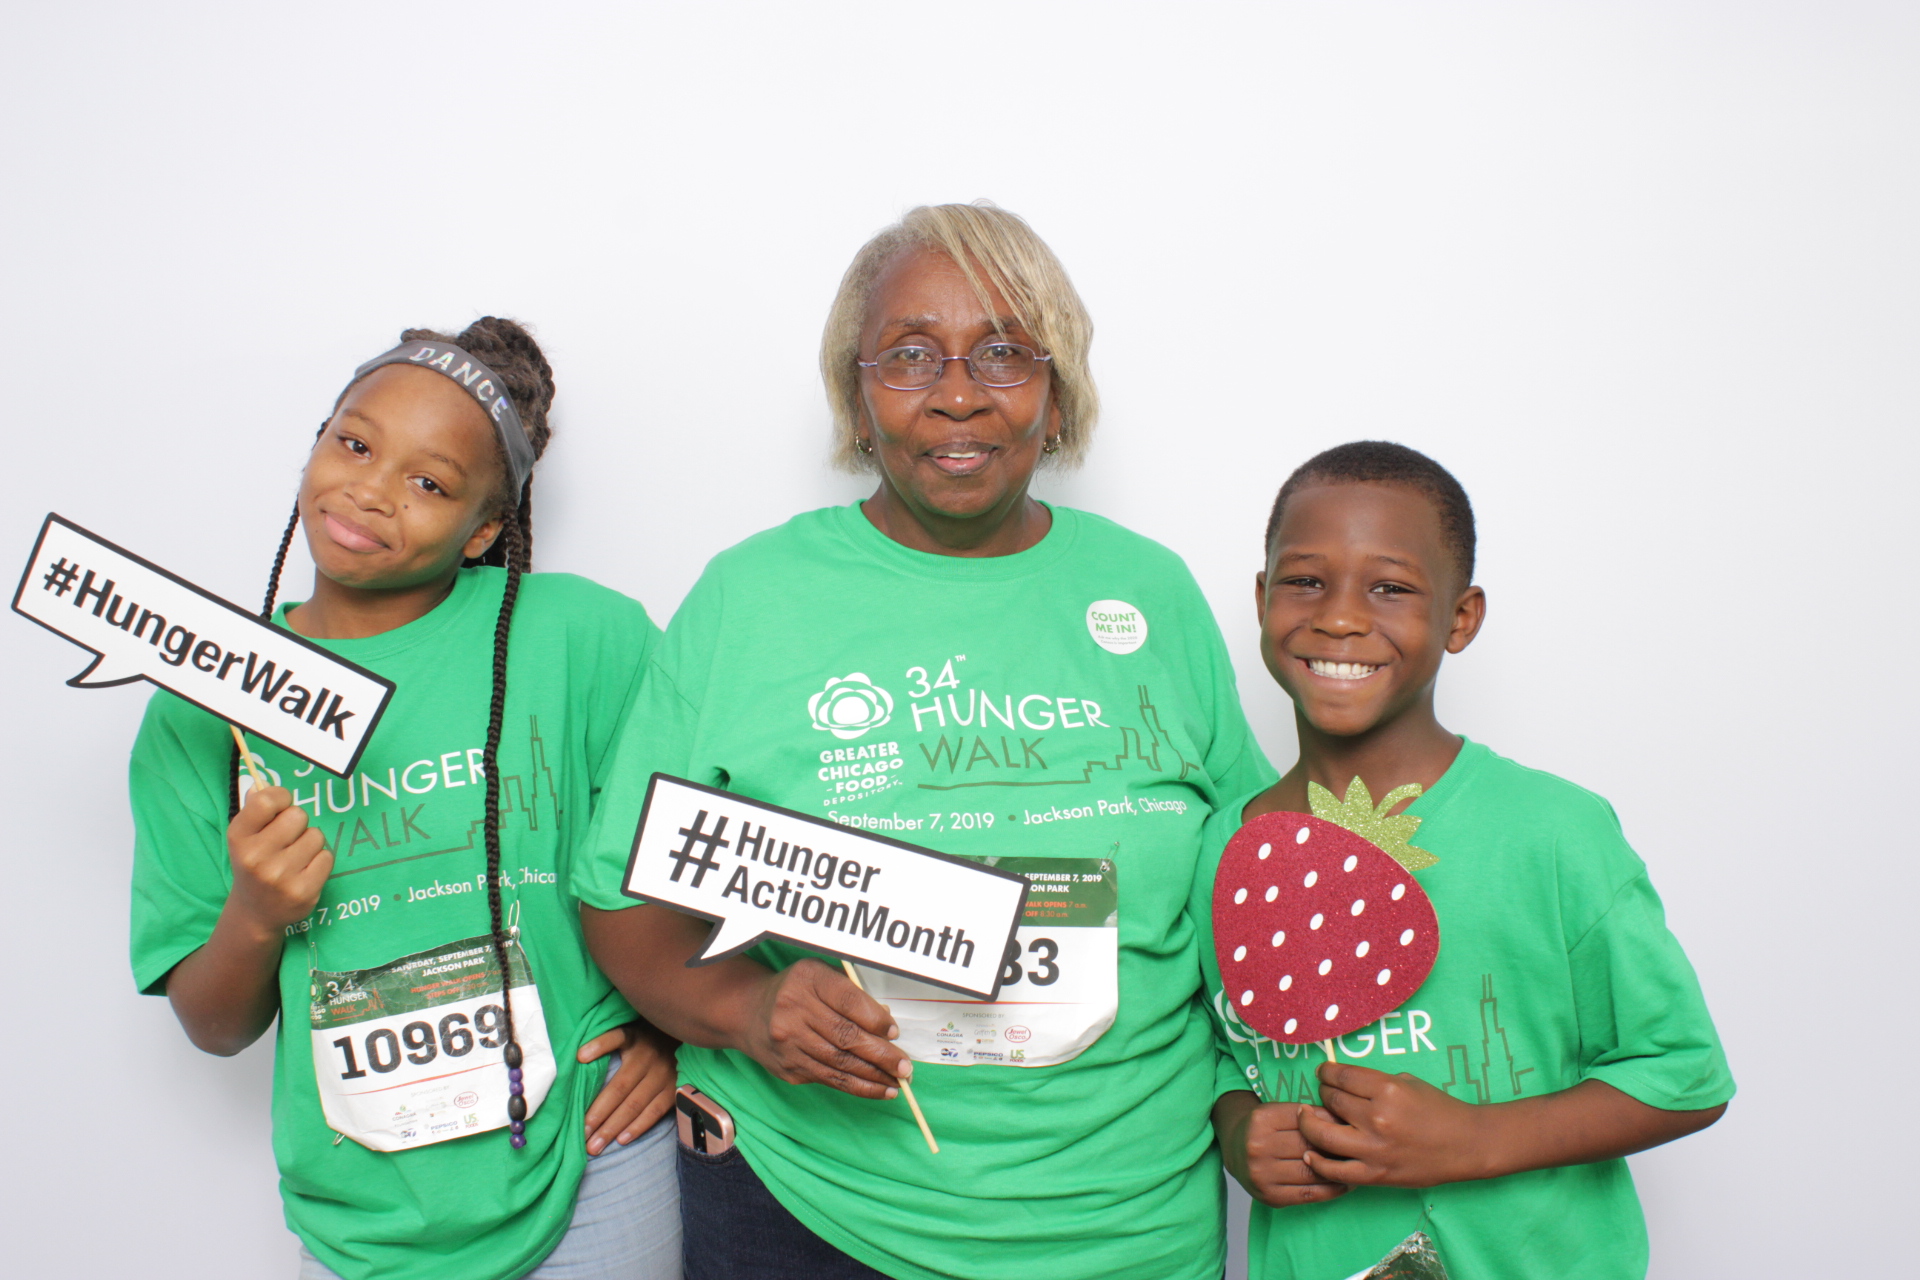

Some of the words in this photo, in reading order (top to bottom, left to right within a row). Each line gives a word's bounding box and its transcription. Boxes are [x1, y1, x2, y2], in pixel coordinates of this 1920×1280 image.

[409, 347, 508, 422] DANCE
[1091, 611, 1136, 622] COUNT
[1095, 623, 1113, 633] ME
[1116, 624, 1136, 633] IN!
[43, 557, 356, 741] #HungerWalk
[911, 688, 1111, 732] HUNGER
[819, 741, 900, 764] GREATER
[918, 734, 1048, 775] WALK
[817, 758, 904, 782] CHICAGO
[1023, 806, 1094, 825] Jackson
[1097, 795, 1138, 816] Park,
[1138, 797, 1187, 815] Chicago
[929, 813, 944, 833] 7,
[949, 811, 995, 830] 2019
[1046, 884, 1070, 893] PARK
[1072, 874, 1079, 883] 7,
[1082, 874, 1103, 882] 2019
[316, 907, 332, 926] 7,
[336, 894, 381, 920] 2019
[407, 879, 472, 903] Jackson
[476, 870, 516, 890] Prk,
[721, 864, 976, 968] ActionMonth
[438, 947, 484, 963] SEPTEMBER
[422, 961, 462, 977] JACKSON
[462, 957, 486, 968] PARK
[325, 978, 355, 998] 34
[329, 991, 368, 1006] HUNGER
[330, 1004, 356, 1016] WALK
[332, 1003, 508, 1081] 10969
